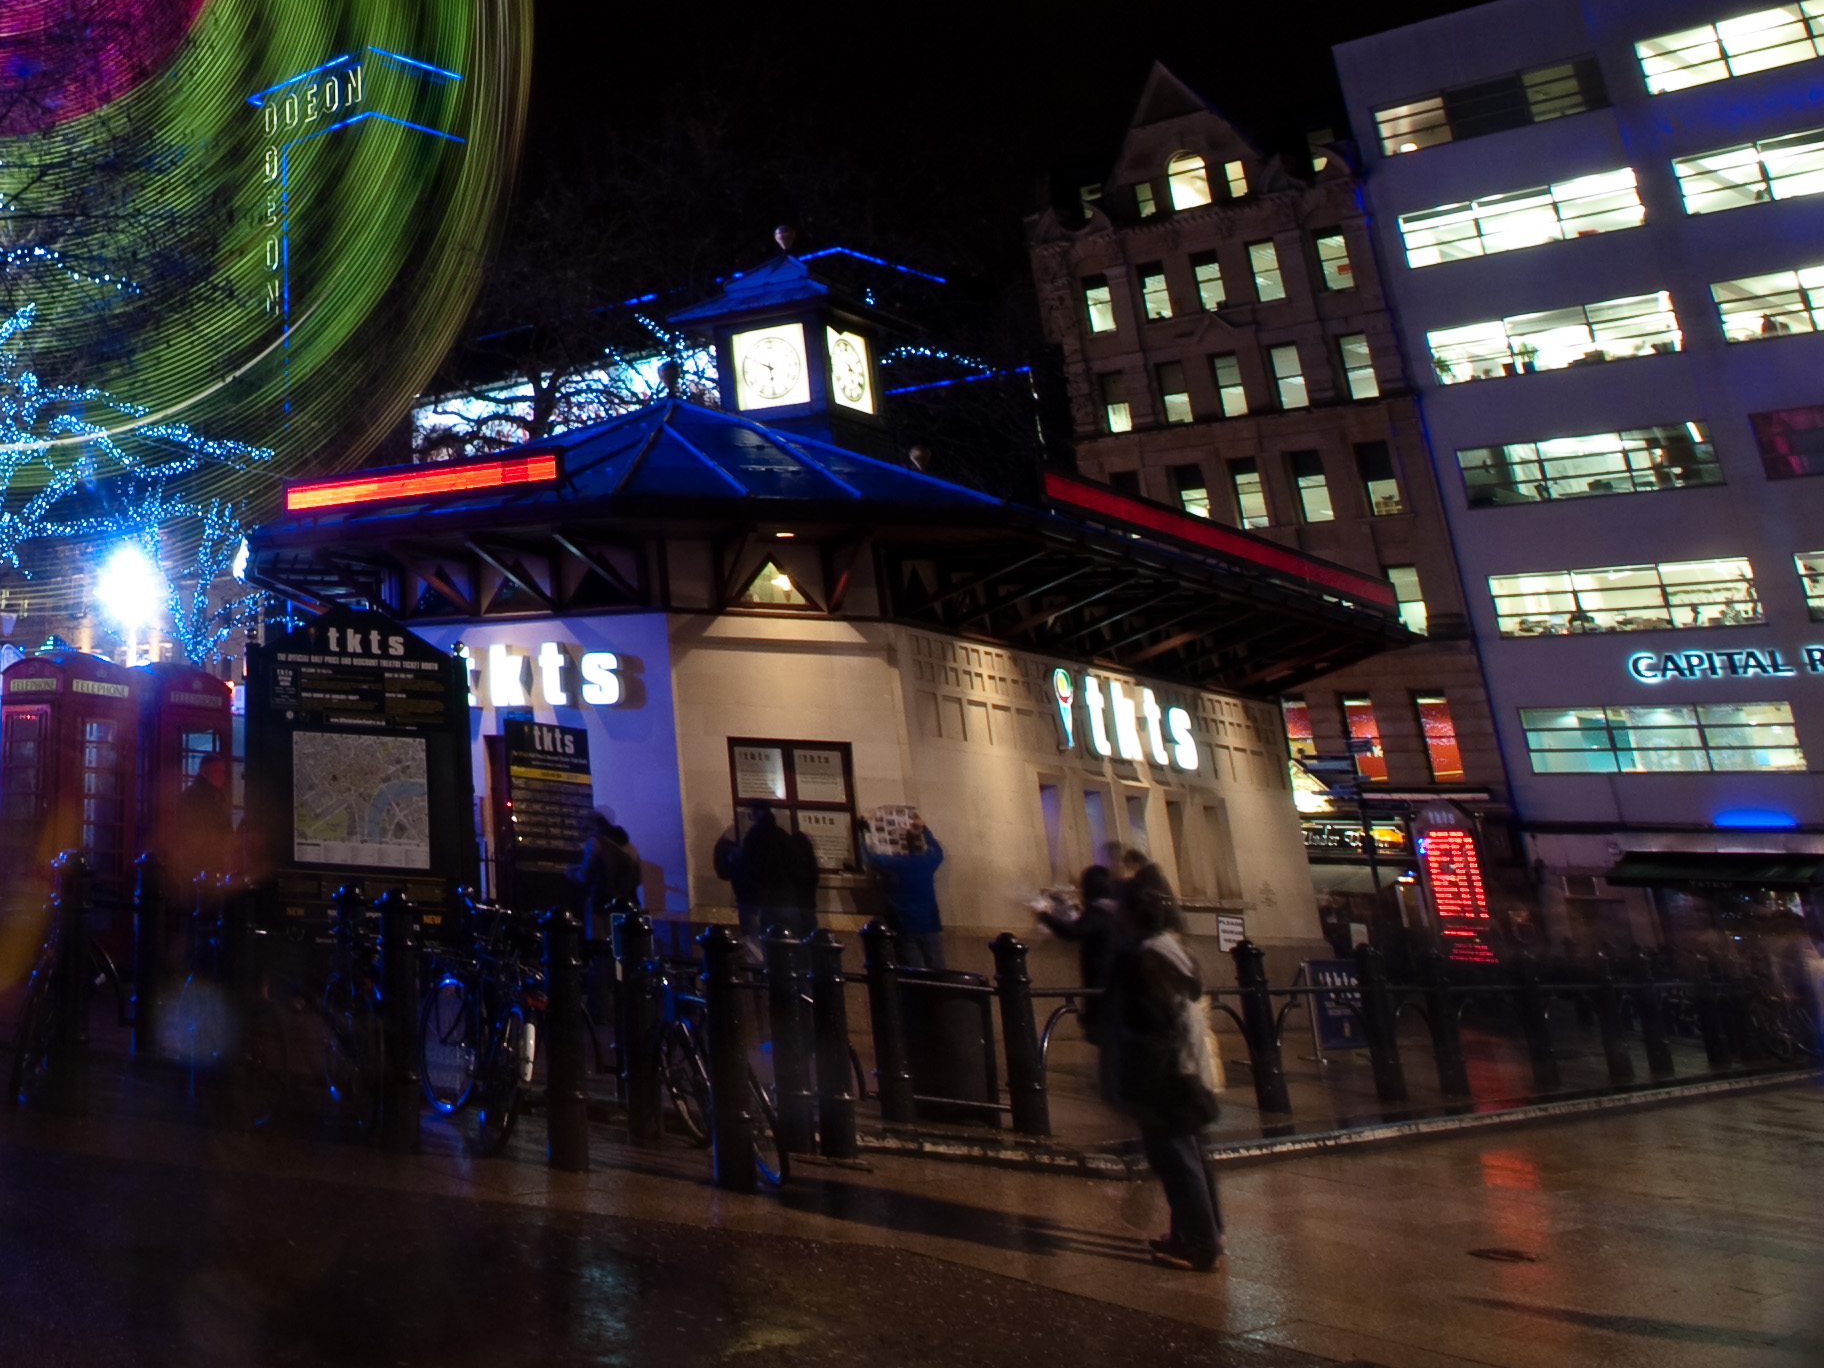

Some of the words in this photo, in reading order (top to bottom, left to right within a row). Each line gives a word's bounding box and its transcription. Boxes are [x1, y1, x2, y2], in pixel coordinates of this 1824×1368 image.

[264, 65, 364, 138] ODEON
[327, 626, 405, 656] tkts
[1629, 648, 1796, 681] CAPITAL
[75, 680, 129, 697] TELEPHONE
[532, 725, 575, 754] tkts
[423, 914, 443, 925] NEW
